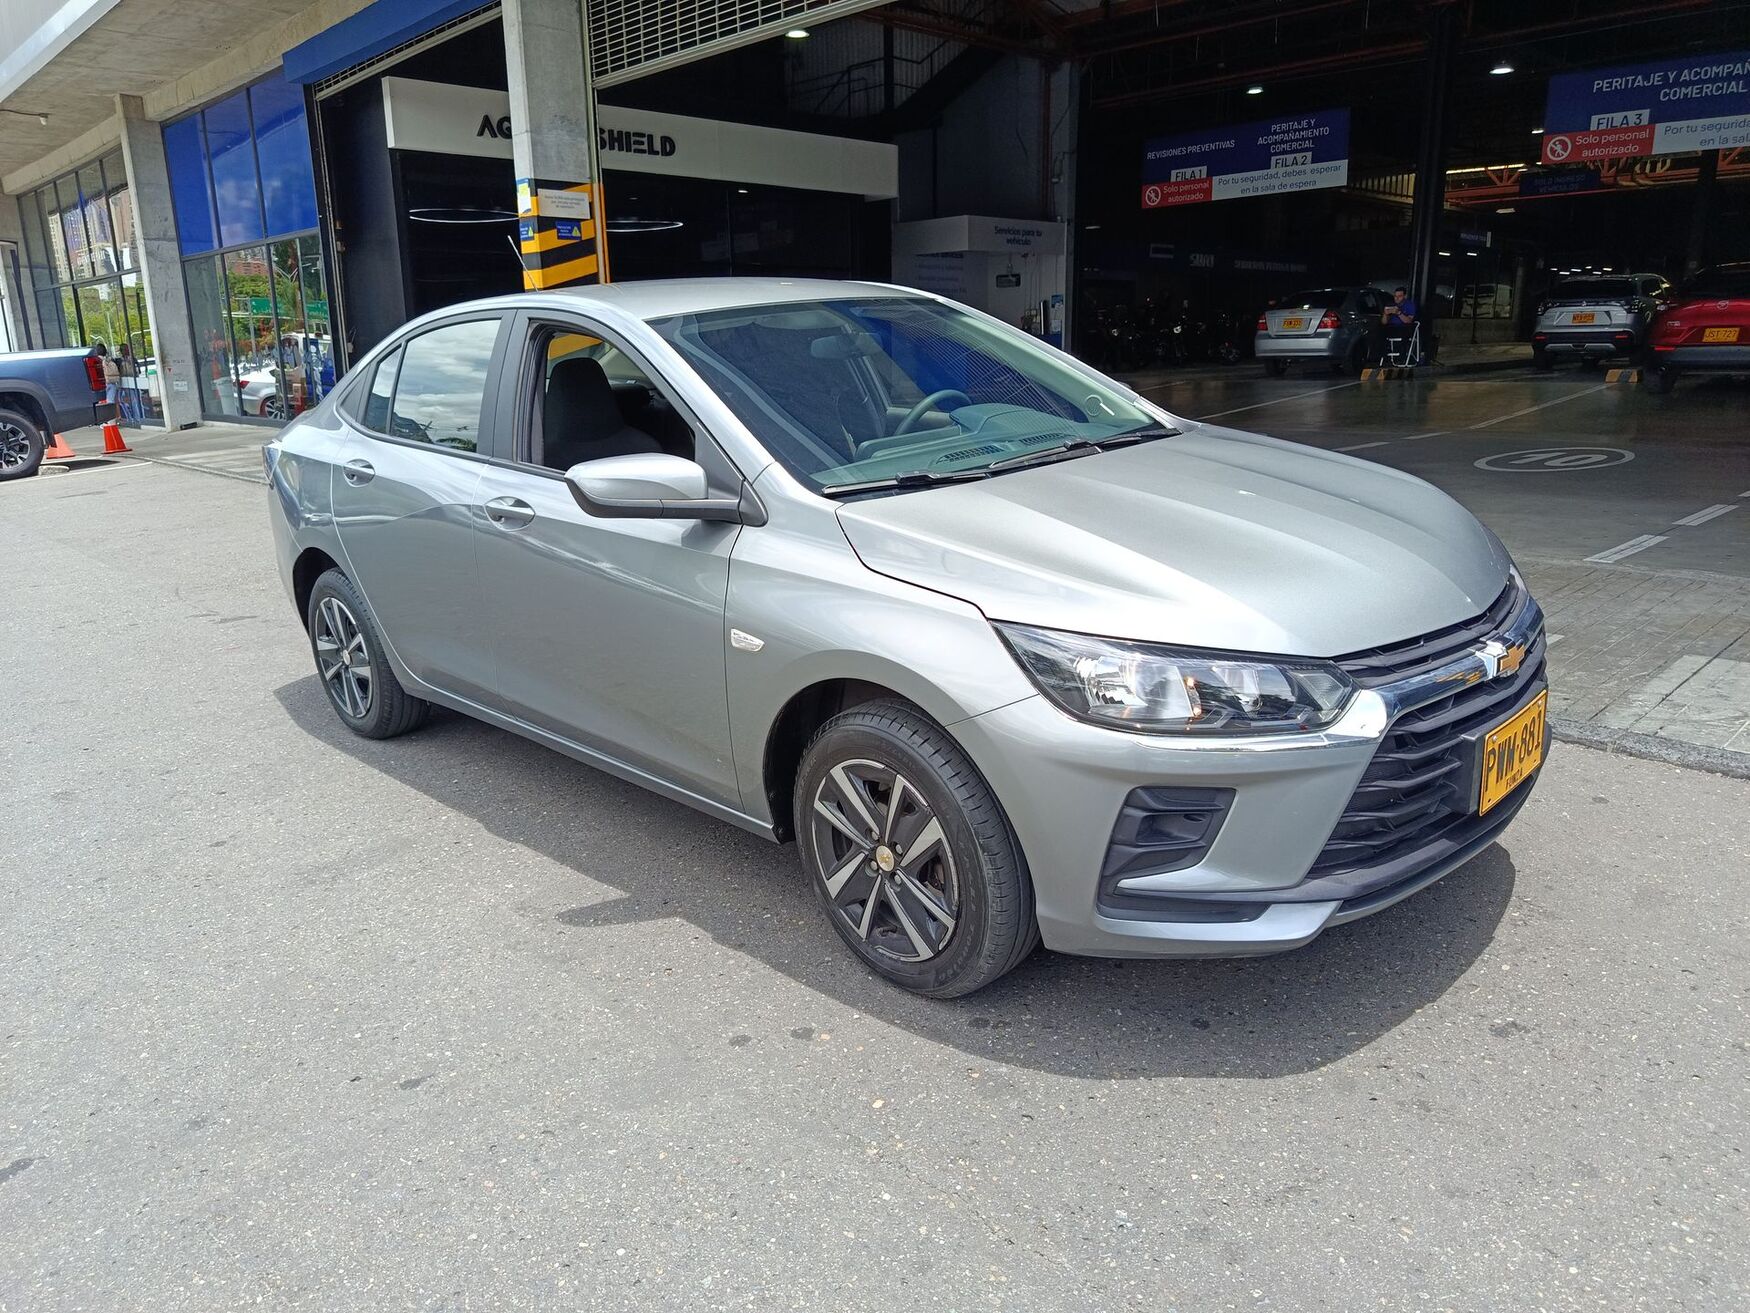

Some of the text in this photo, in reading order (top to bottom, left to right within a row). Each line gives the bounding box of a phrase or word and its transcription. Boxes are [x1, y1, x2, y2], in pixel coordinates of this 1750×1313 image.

[1592, 72, 1664, 93] PERITAJE
[1667, 70, 1678, 83] Y
[1659, 80, 1748, 101] COMERCIAL
[1271, 118, 1316, 132] PERITAJE Y
[1596, 113, 1643, 130] FILA 3
[1257, 126, 1330, 145] ACOMPAÑAMIENTO
[1575, 129, 1649, 145] Solo personal
[1664, 125, 1684, 136] Por
[1686, 124, 1698, 133] tu
[1270, 139, 1315, 153] COMERCIAL
[1700, 132, 1750, 147] en la sal
[1146, 139, 1236, 160] REVISIONES PREVENTIVAS
[1582, 144, 1640, 157] autorizado
[1275, 155, 1308, 168] FILA 2
[1175, 170, 1196, 181] FILA
[1218, 164, 1342, 186] Por tu seguridad, debes esperar
[1163, 181, 1210, 194] Solo personal
[1241, 180, 1317, 195] en la sala de espera
[1167, 193, 1204, 202] autorizado
[1508, 452, 1608, 467] 10
